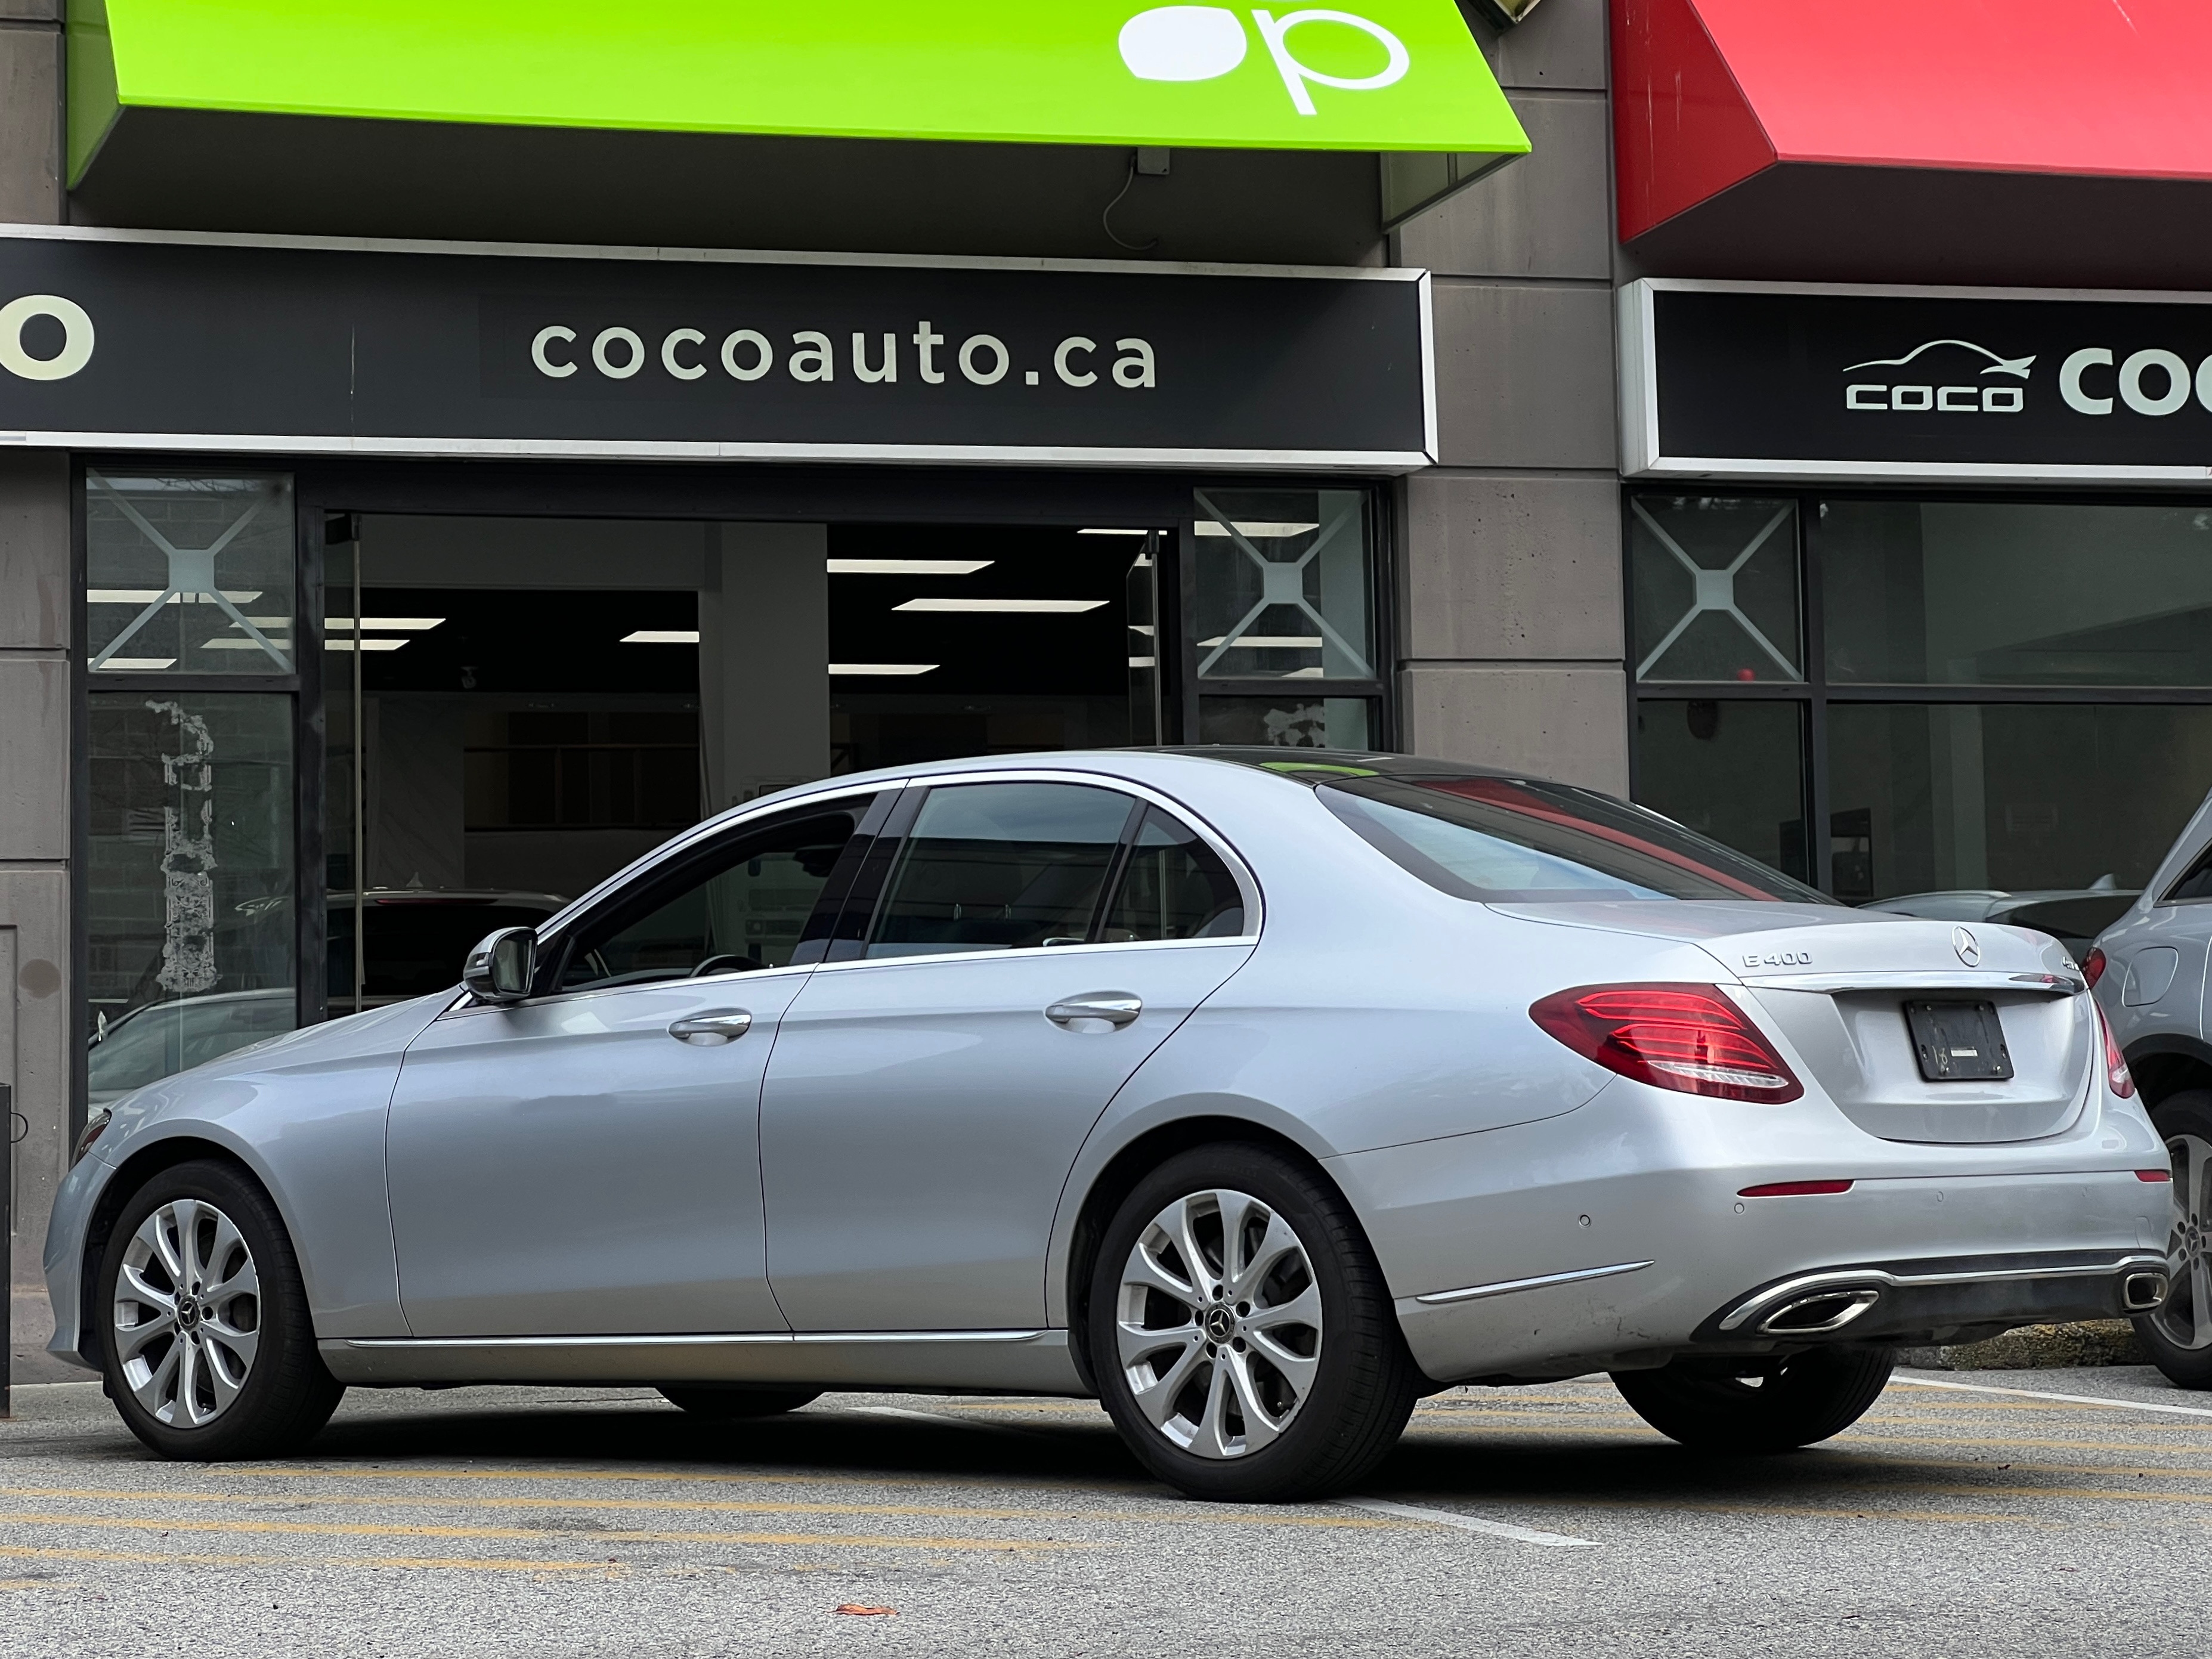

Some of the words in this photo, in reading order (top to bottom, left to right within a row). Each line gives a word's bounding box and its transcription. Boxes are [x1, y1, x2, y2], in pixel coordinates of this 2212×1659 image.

[531, 321, 1156, 388] cocoauto.ca
[1742, 954, 1761, 967] E
[1764, 951, 1812, 965] 400
